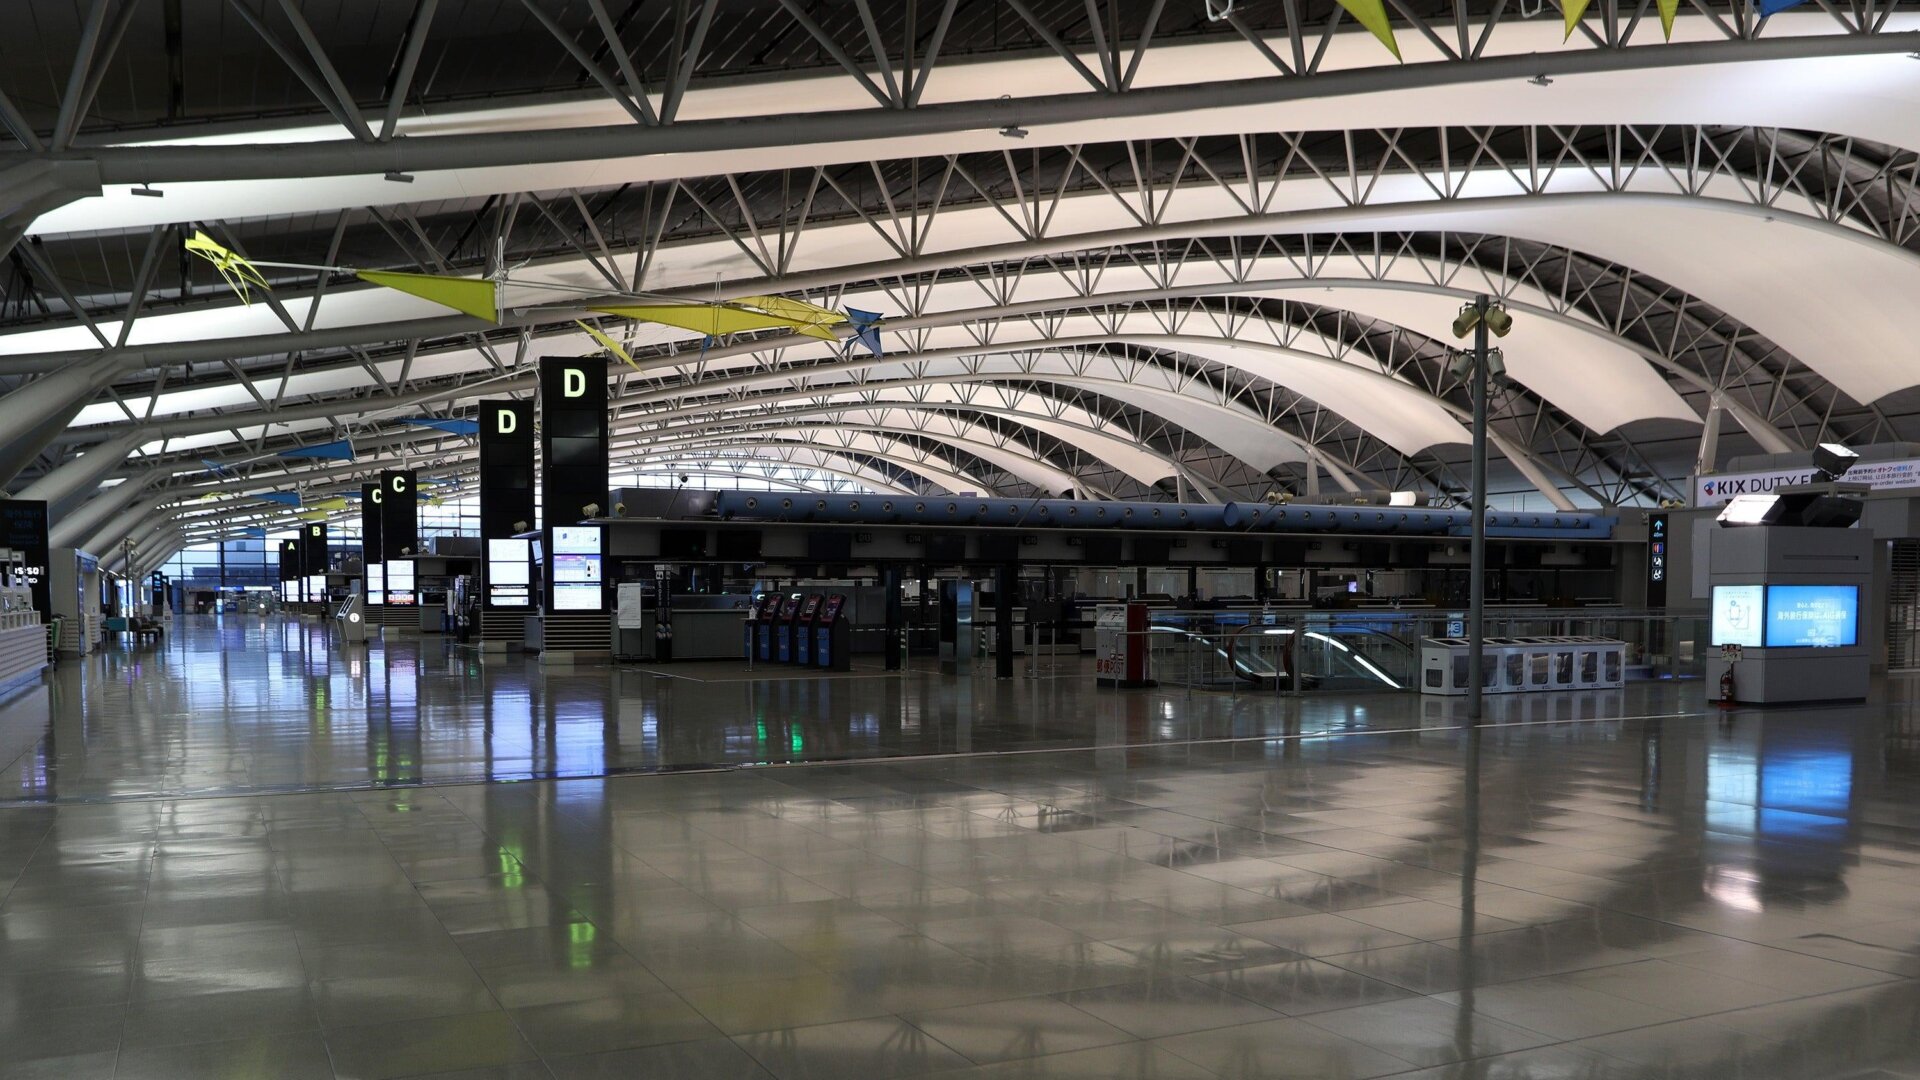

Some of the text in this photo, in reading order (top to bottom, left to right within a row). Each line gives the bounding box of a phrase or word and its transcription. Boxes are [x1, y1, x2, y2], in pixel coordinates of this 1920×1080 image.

[564, 369, 585, 397] D
[498, 410, 516, 433] D
[393, 476, 405, 492] C
[1718, 480, 1745, 494] KIX
[1750, 475, 1797, 493] DUTY
[371, 488, 381, 504] C
[312, 526, 321, 537] B
[287, 541, 295, 551] A
